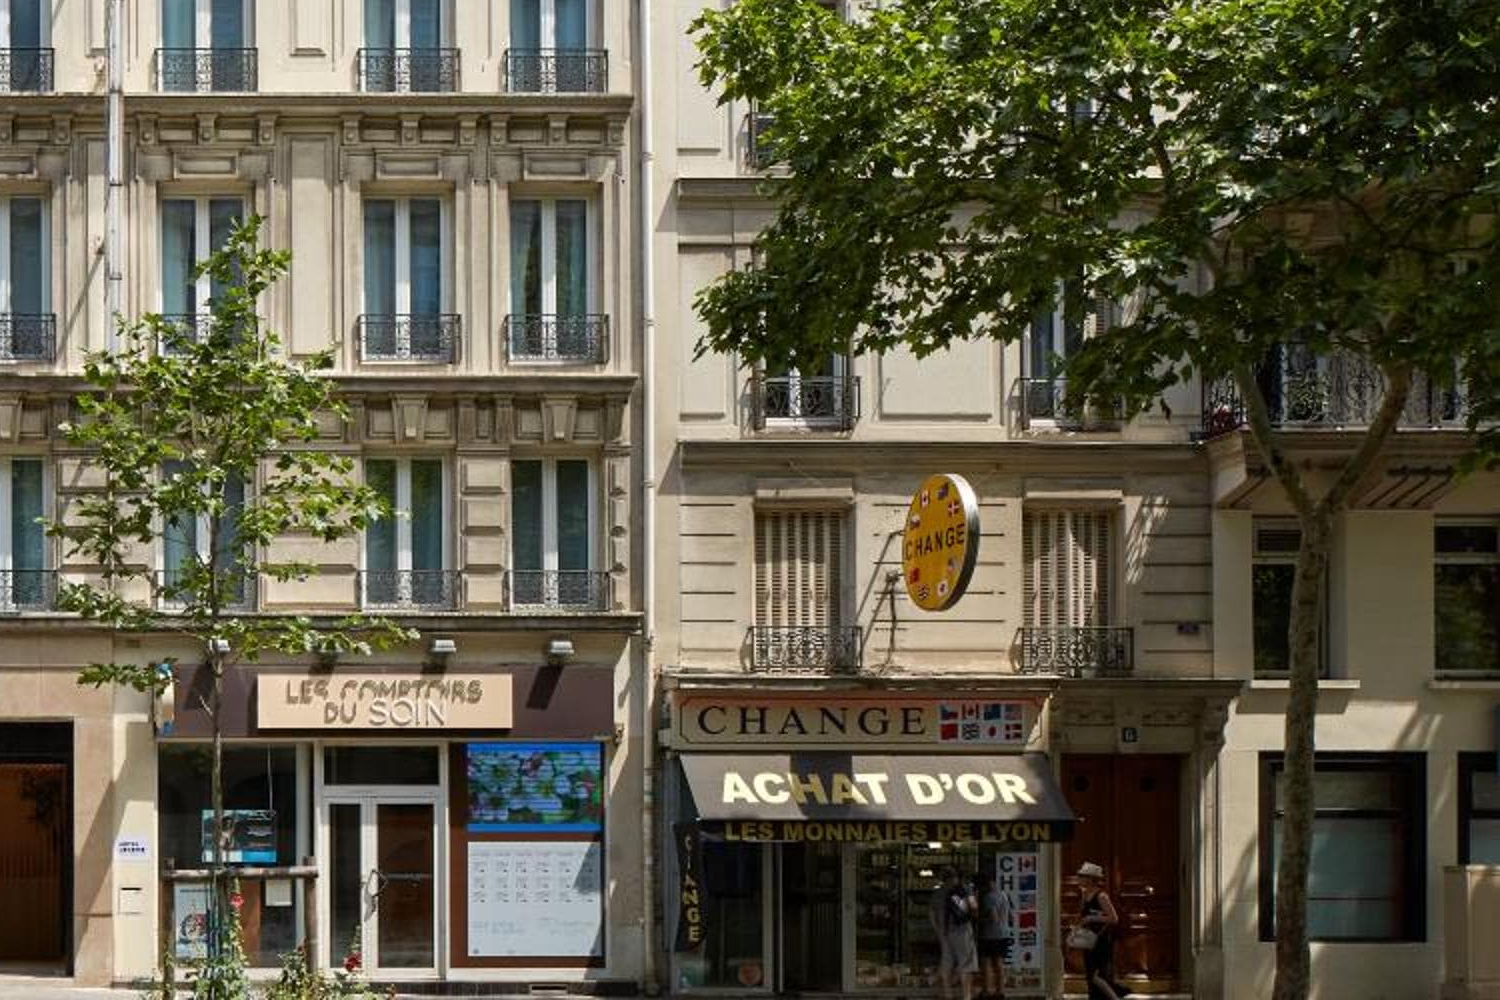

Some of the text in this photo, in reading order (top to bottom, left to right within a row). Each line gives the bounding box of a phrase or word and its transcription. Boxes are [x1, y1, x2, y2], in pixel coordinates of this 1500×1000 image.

[905, 523, 965, 561] CHANGE
[285, 679, 329, 704] LES
[323, 698, 446, 727] DU SOIN
[697, 706, 926, 736] CHANGE
[722, 772, 1037, 805] ACHAT D'OR
[725, 823, 1049, 842] LES MONNAIES DE LYON
